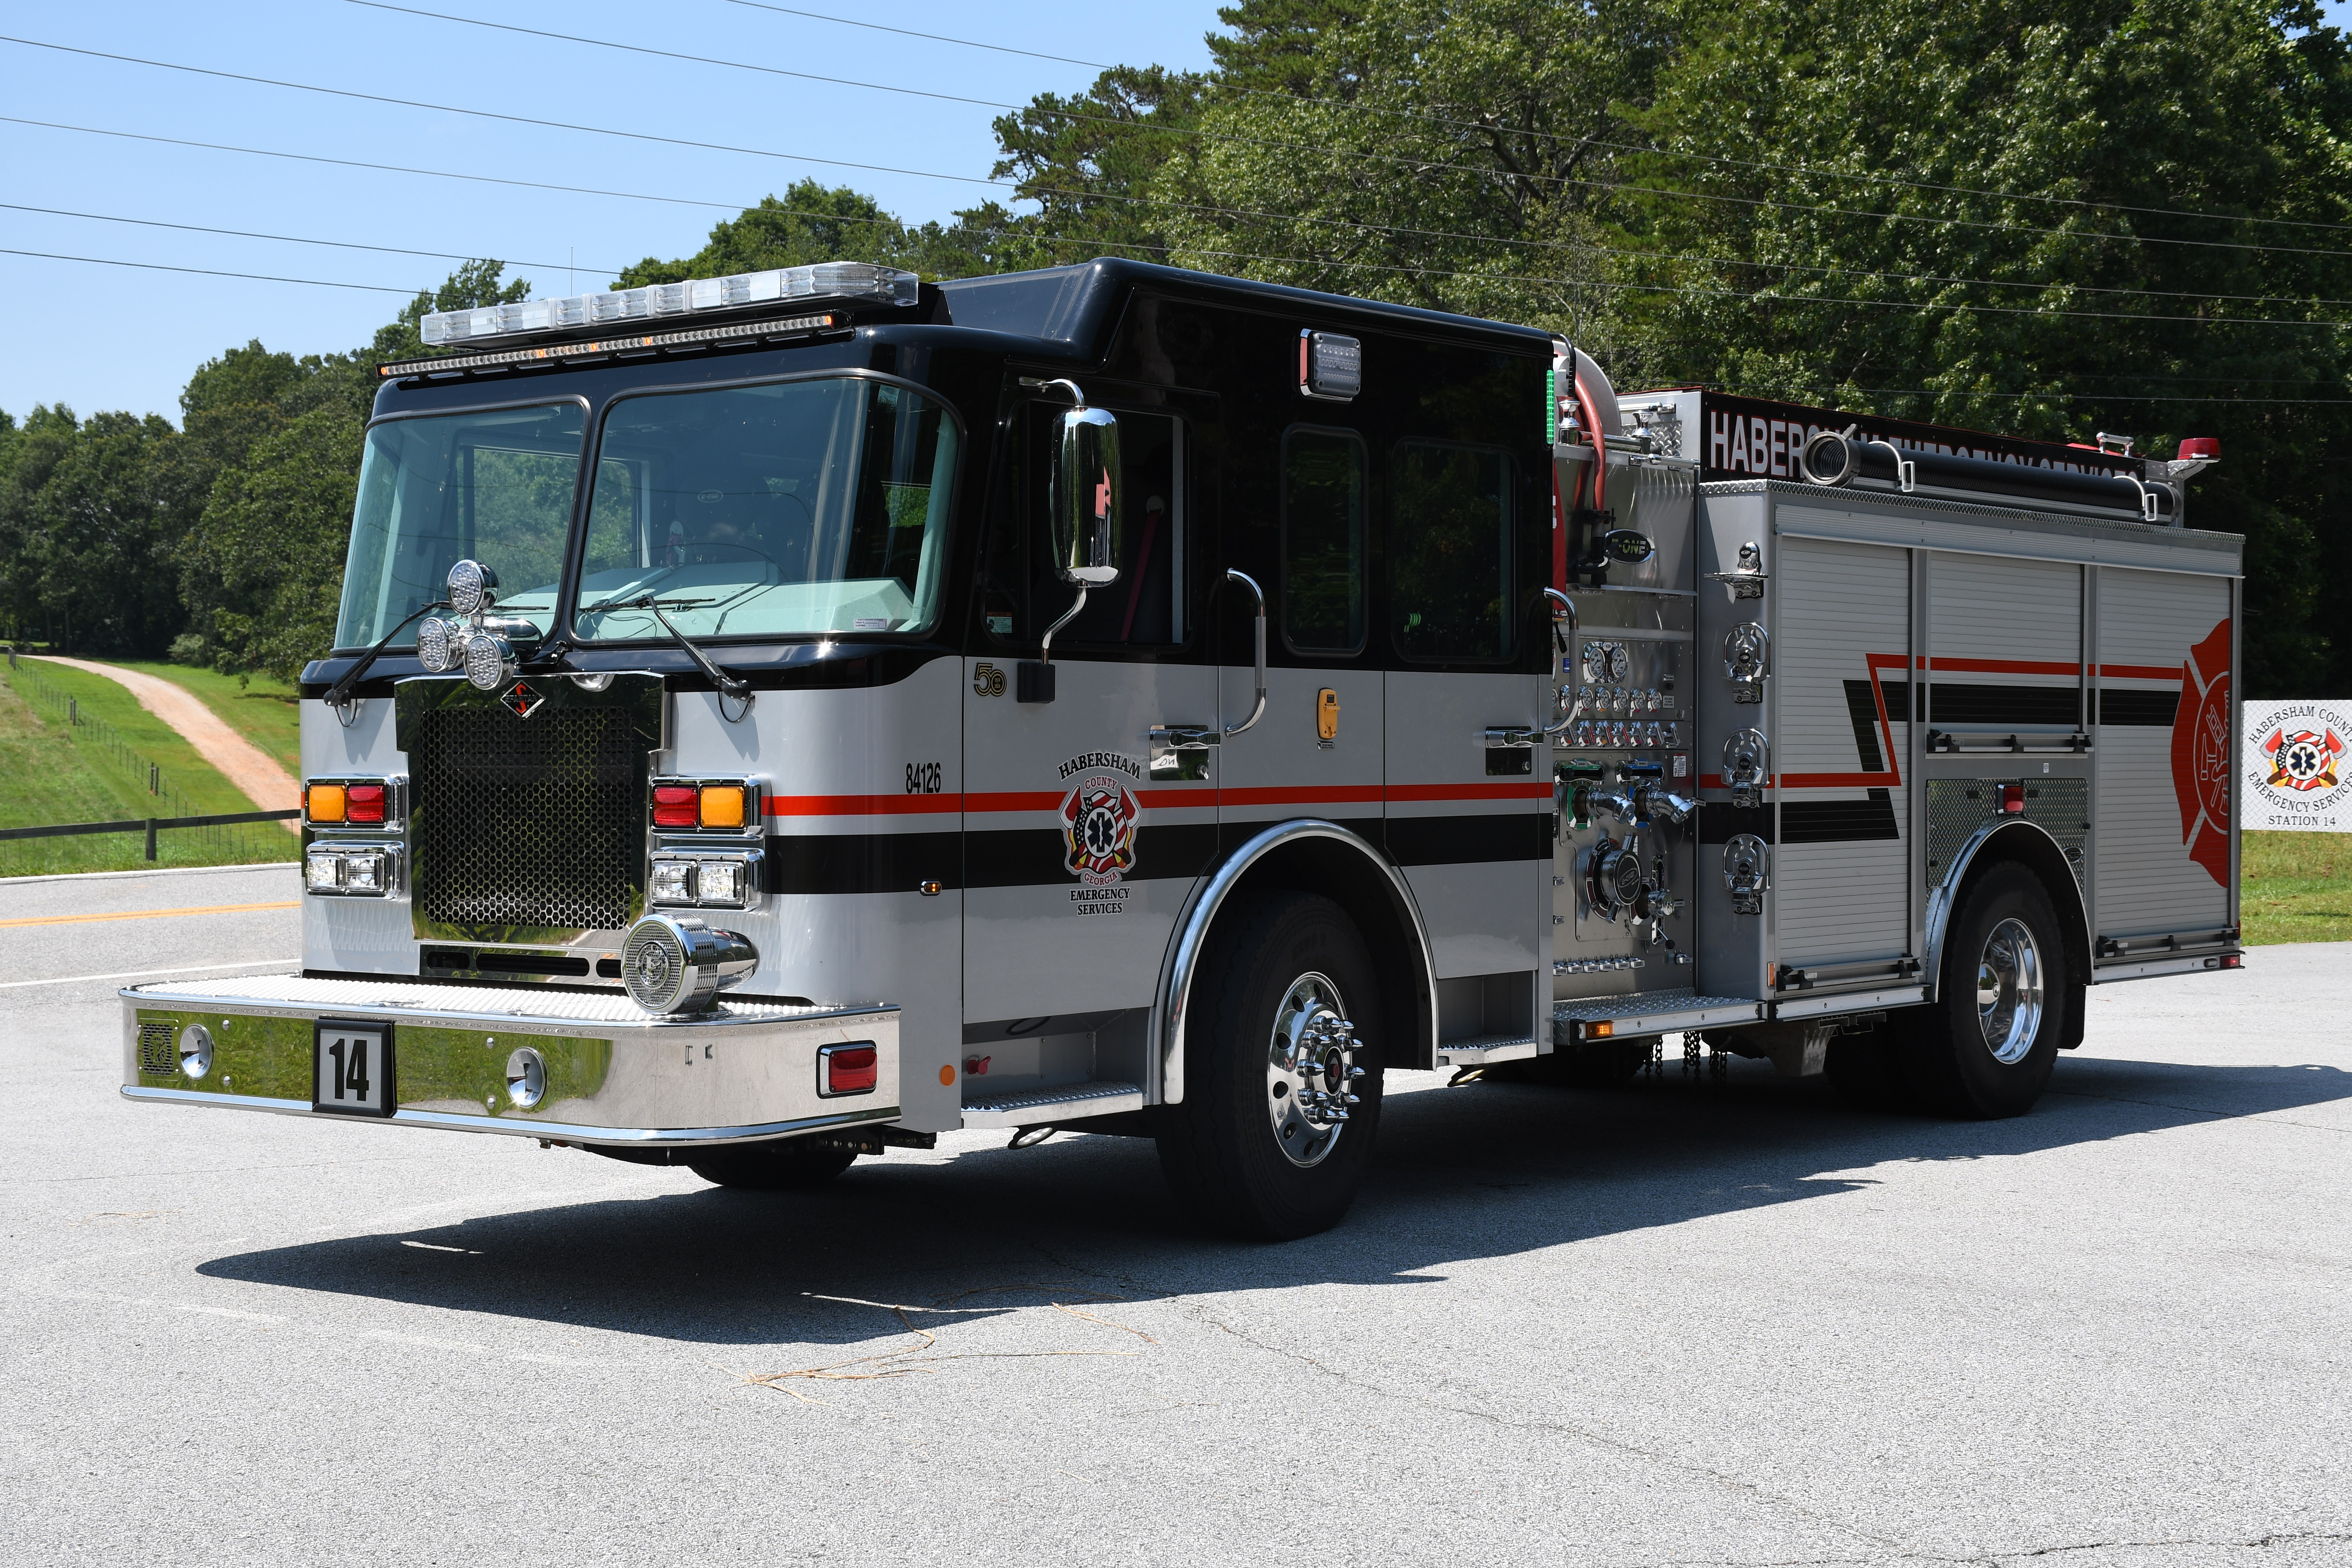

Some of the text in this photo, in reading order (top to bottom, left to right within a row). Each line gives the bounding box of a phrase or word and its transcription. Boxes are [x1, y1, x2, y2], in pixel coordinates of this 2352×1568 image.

[974, 663, 1007, 697] 50
[504, 694, 538, 703] SPARTAN
[2248, 705, 2352, 744] HABERSHAM COUNT
[1058, 752, 1141, 781] HABERSHAM
[906, 762, 941, 794] 84126
[1084, 776, 1118, 791] COUNTY
[2248, 771, 2310, 813] EMERGENCY
[2268, 815, 2336, 827] STATION 14
[1083, 872, 1118, 886] GEORGIA
[1070, 887, 1130, 901] EMERGENCY
[1077, 902, 1123, 916] SERVICES
[329, 1038, 370, 1102] 14
